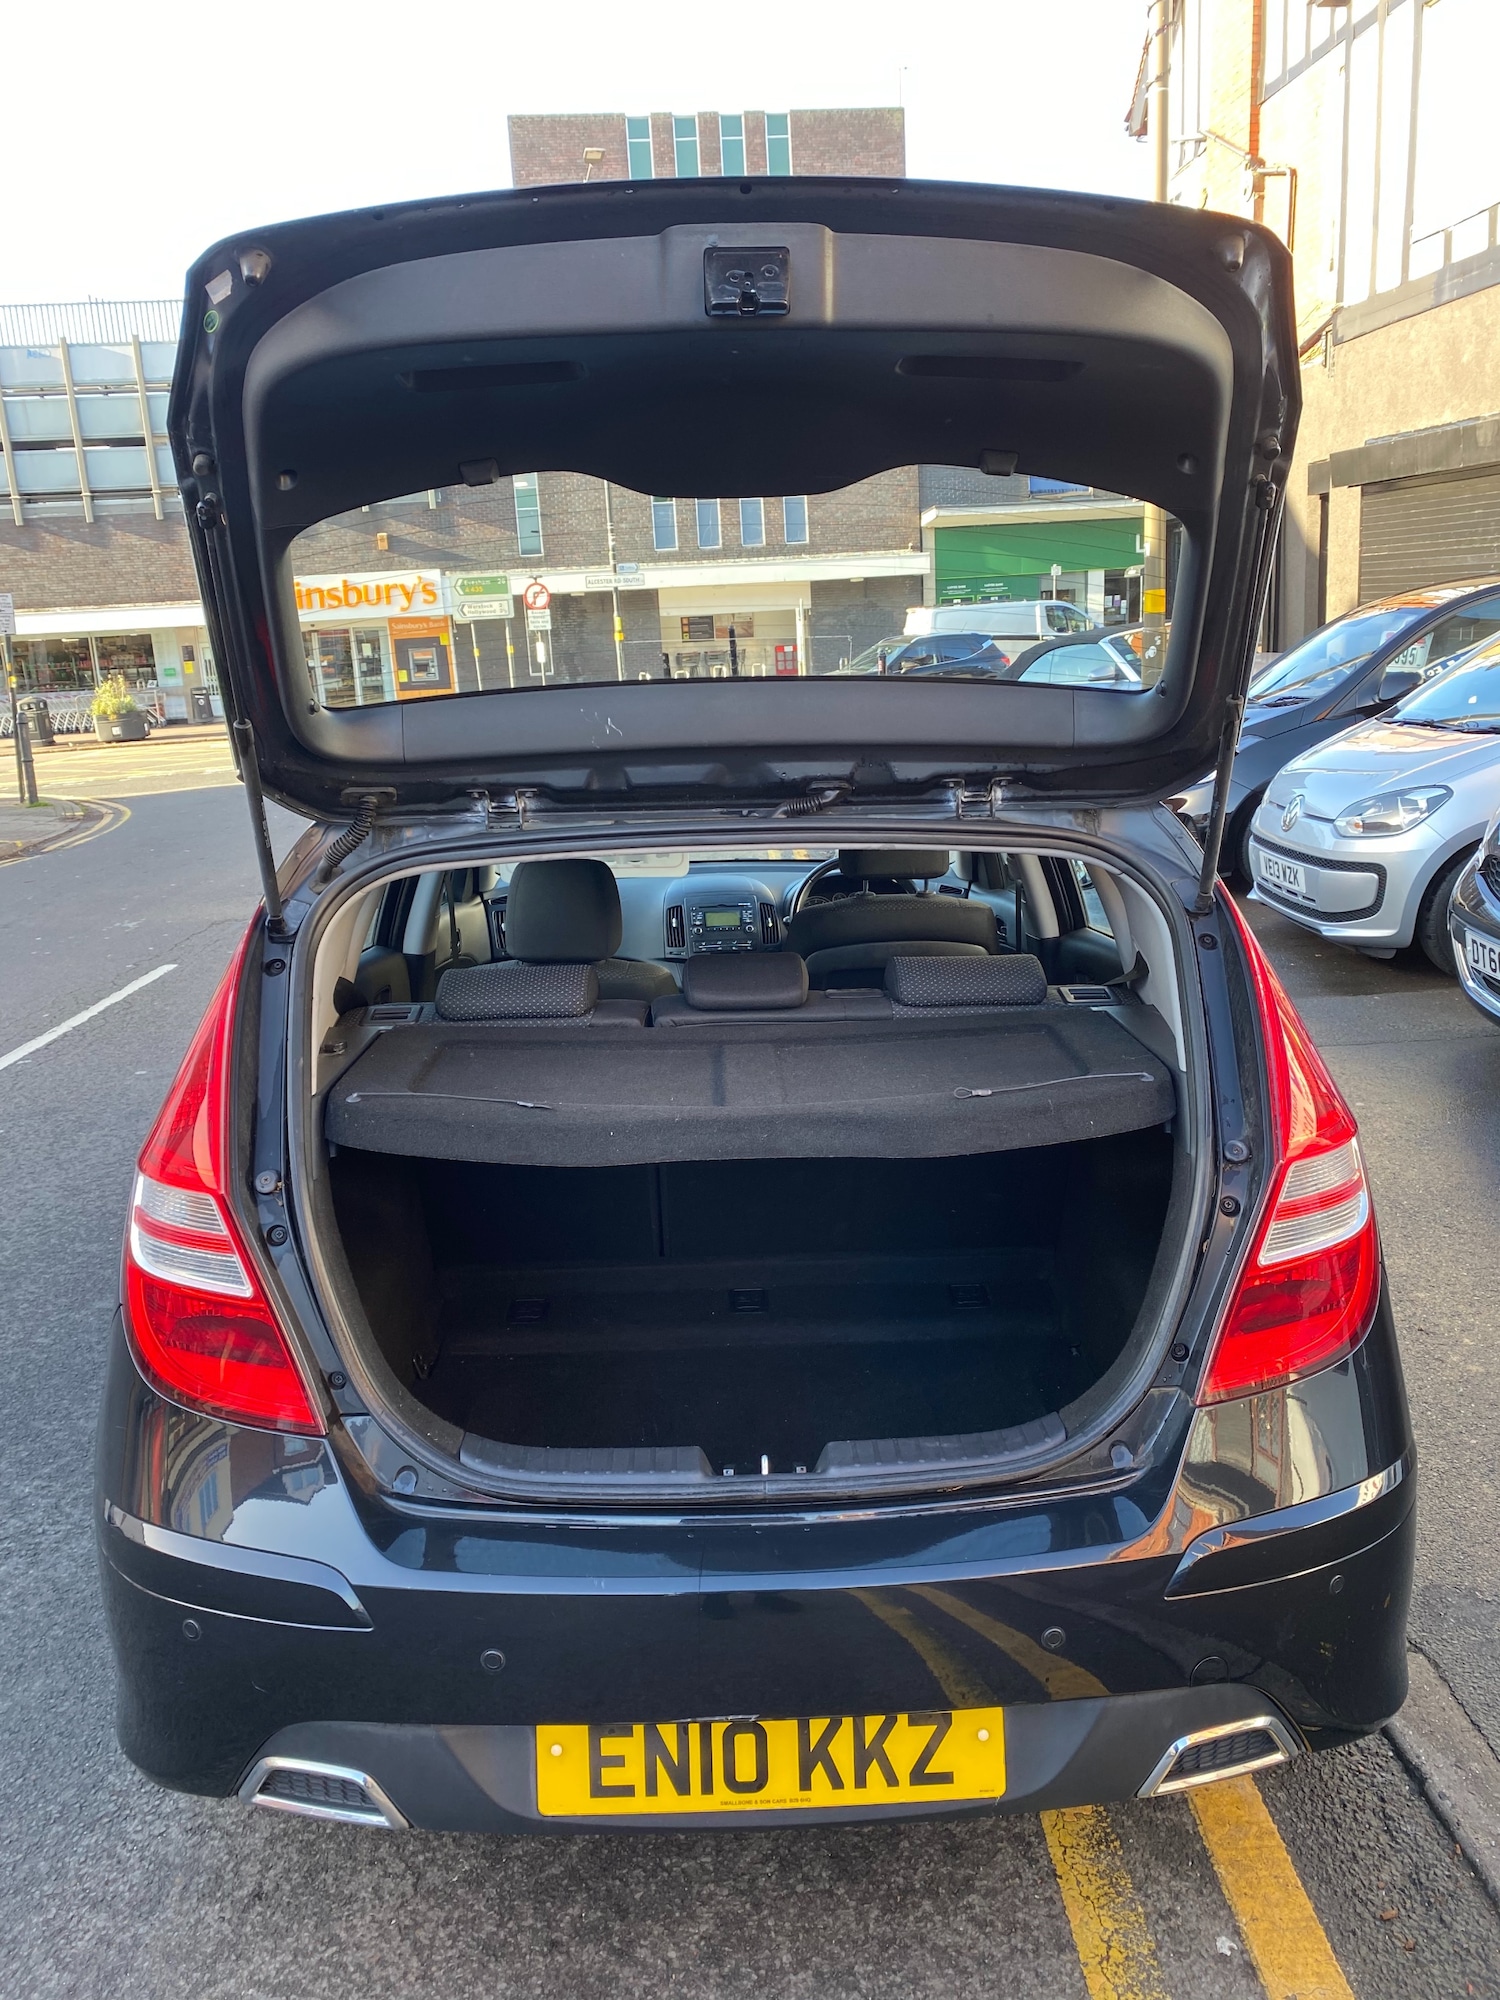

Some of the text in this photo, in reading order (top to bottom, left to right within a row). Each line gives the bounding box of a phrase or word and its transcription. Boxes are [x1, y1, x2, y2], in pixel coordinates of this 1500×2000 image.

[1263, 855, 1300, 887] VE13 WZK
[1471, 938, 1500, 975] DT6
[588, 1712, 955, 1799] EN10 KKZ
